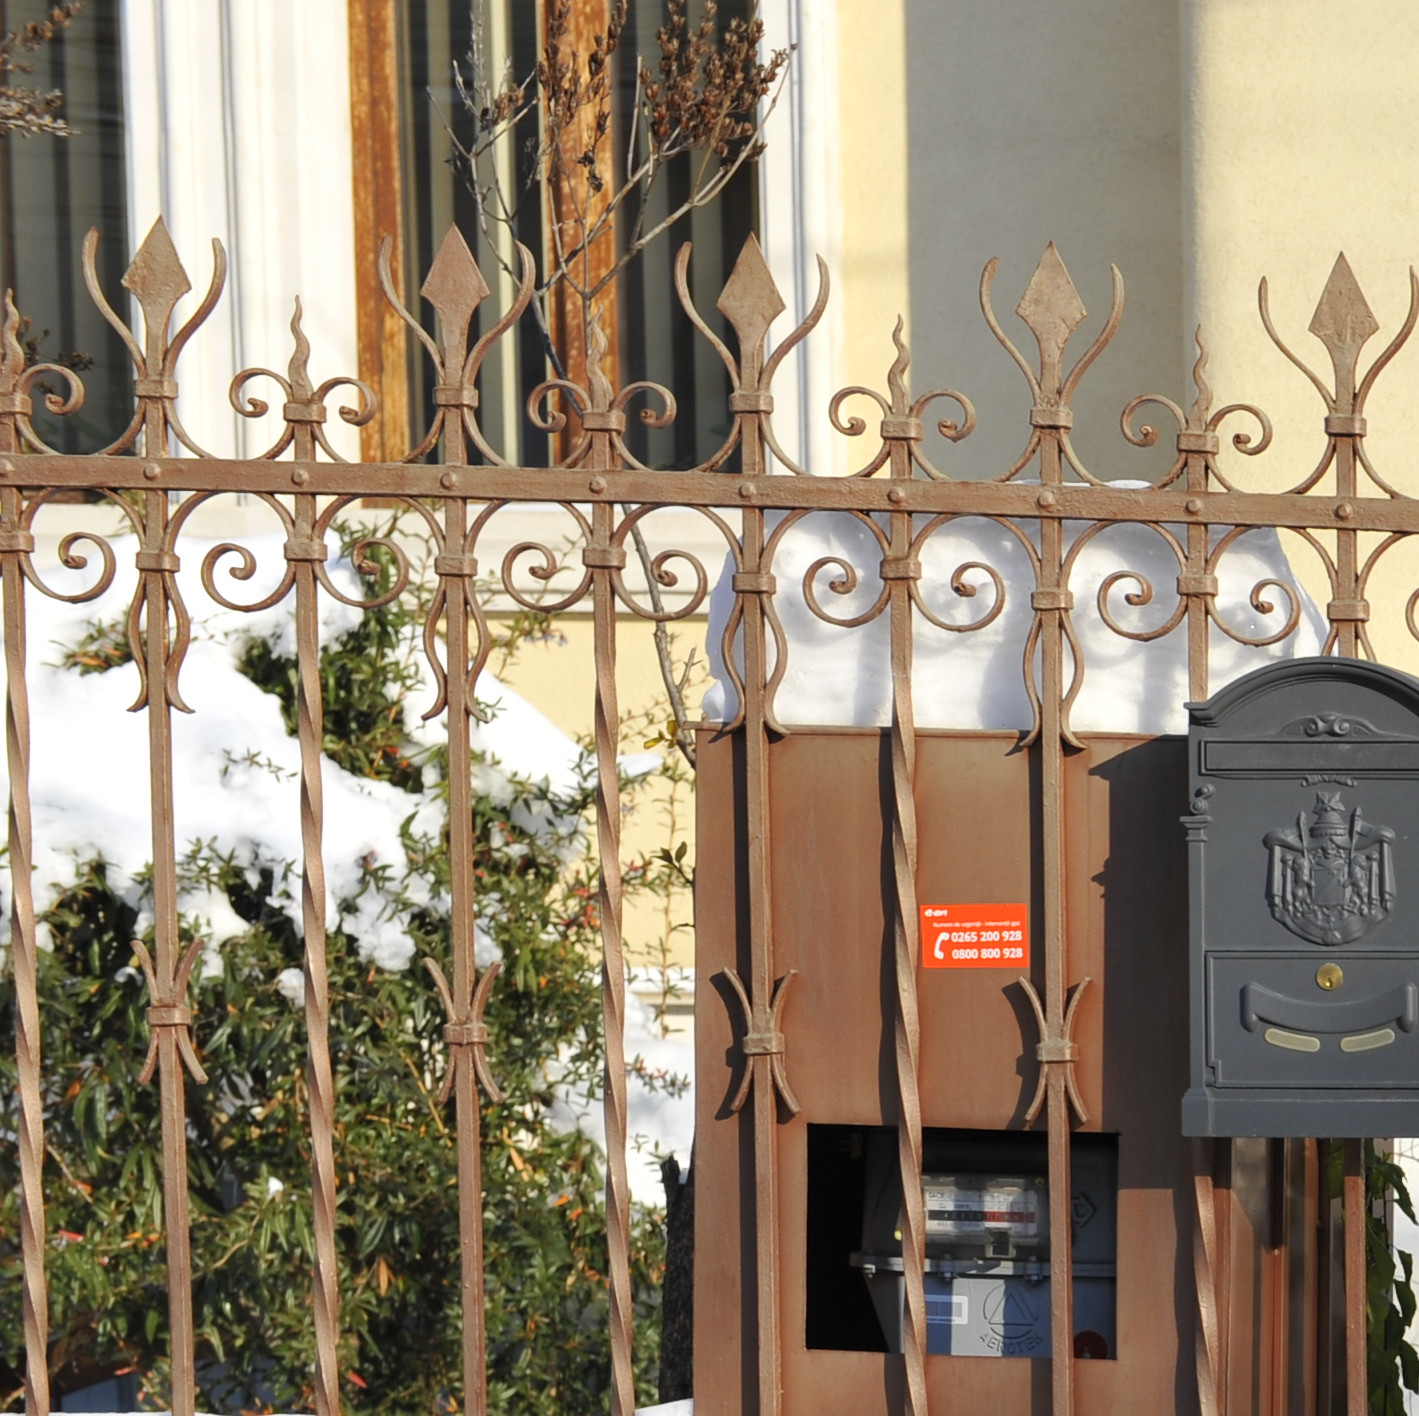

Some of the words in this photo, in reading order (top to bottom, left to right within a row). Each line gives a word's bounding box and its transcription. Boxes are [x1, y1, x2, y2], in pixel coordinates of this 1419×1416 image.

[951, 931, 978, 942] 0265
[979, 931, 1000, 942] 200
[1001, 930, 1023, 941] 928
[952, 949, 978, 959] 0800
[980, 948, 1001, 959] 800
[1002, 947, 1023, 959] 928
